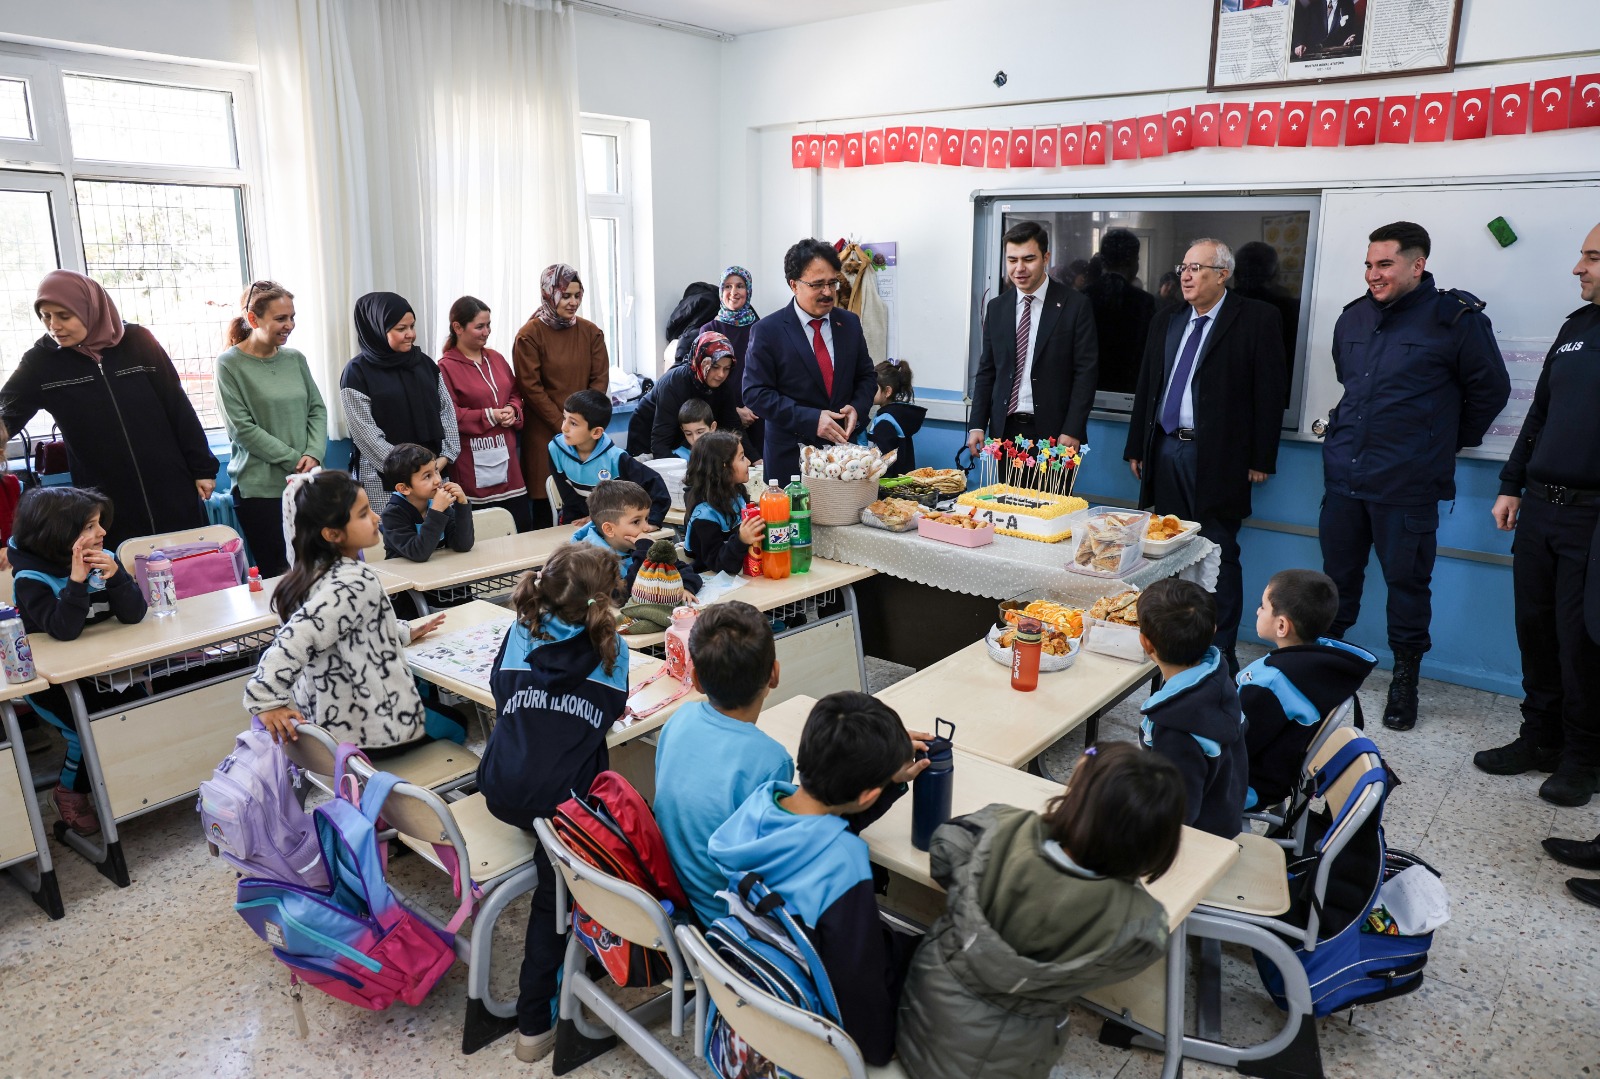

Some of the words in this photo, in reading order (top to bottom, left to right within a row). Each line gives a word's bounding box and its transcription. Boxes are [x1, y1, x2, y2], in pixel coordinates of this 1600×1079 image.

[470, 436, 495, 451] MOOD
[495, 433, 506, 448] ON
[982, 510, 1018, 530] 1-A
